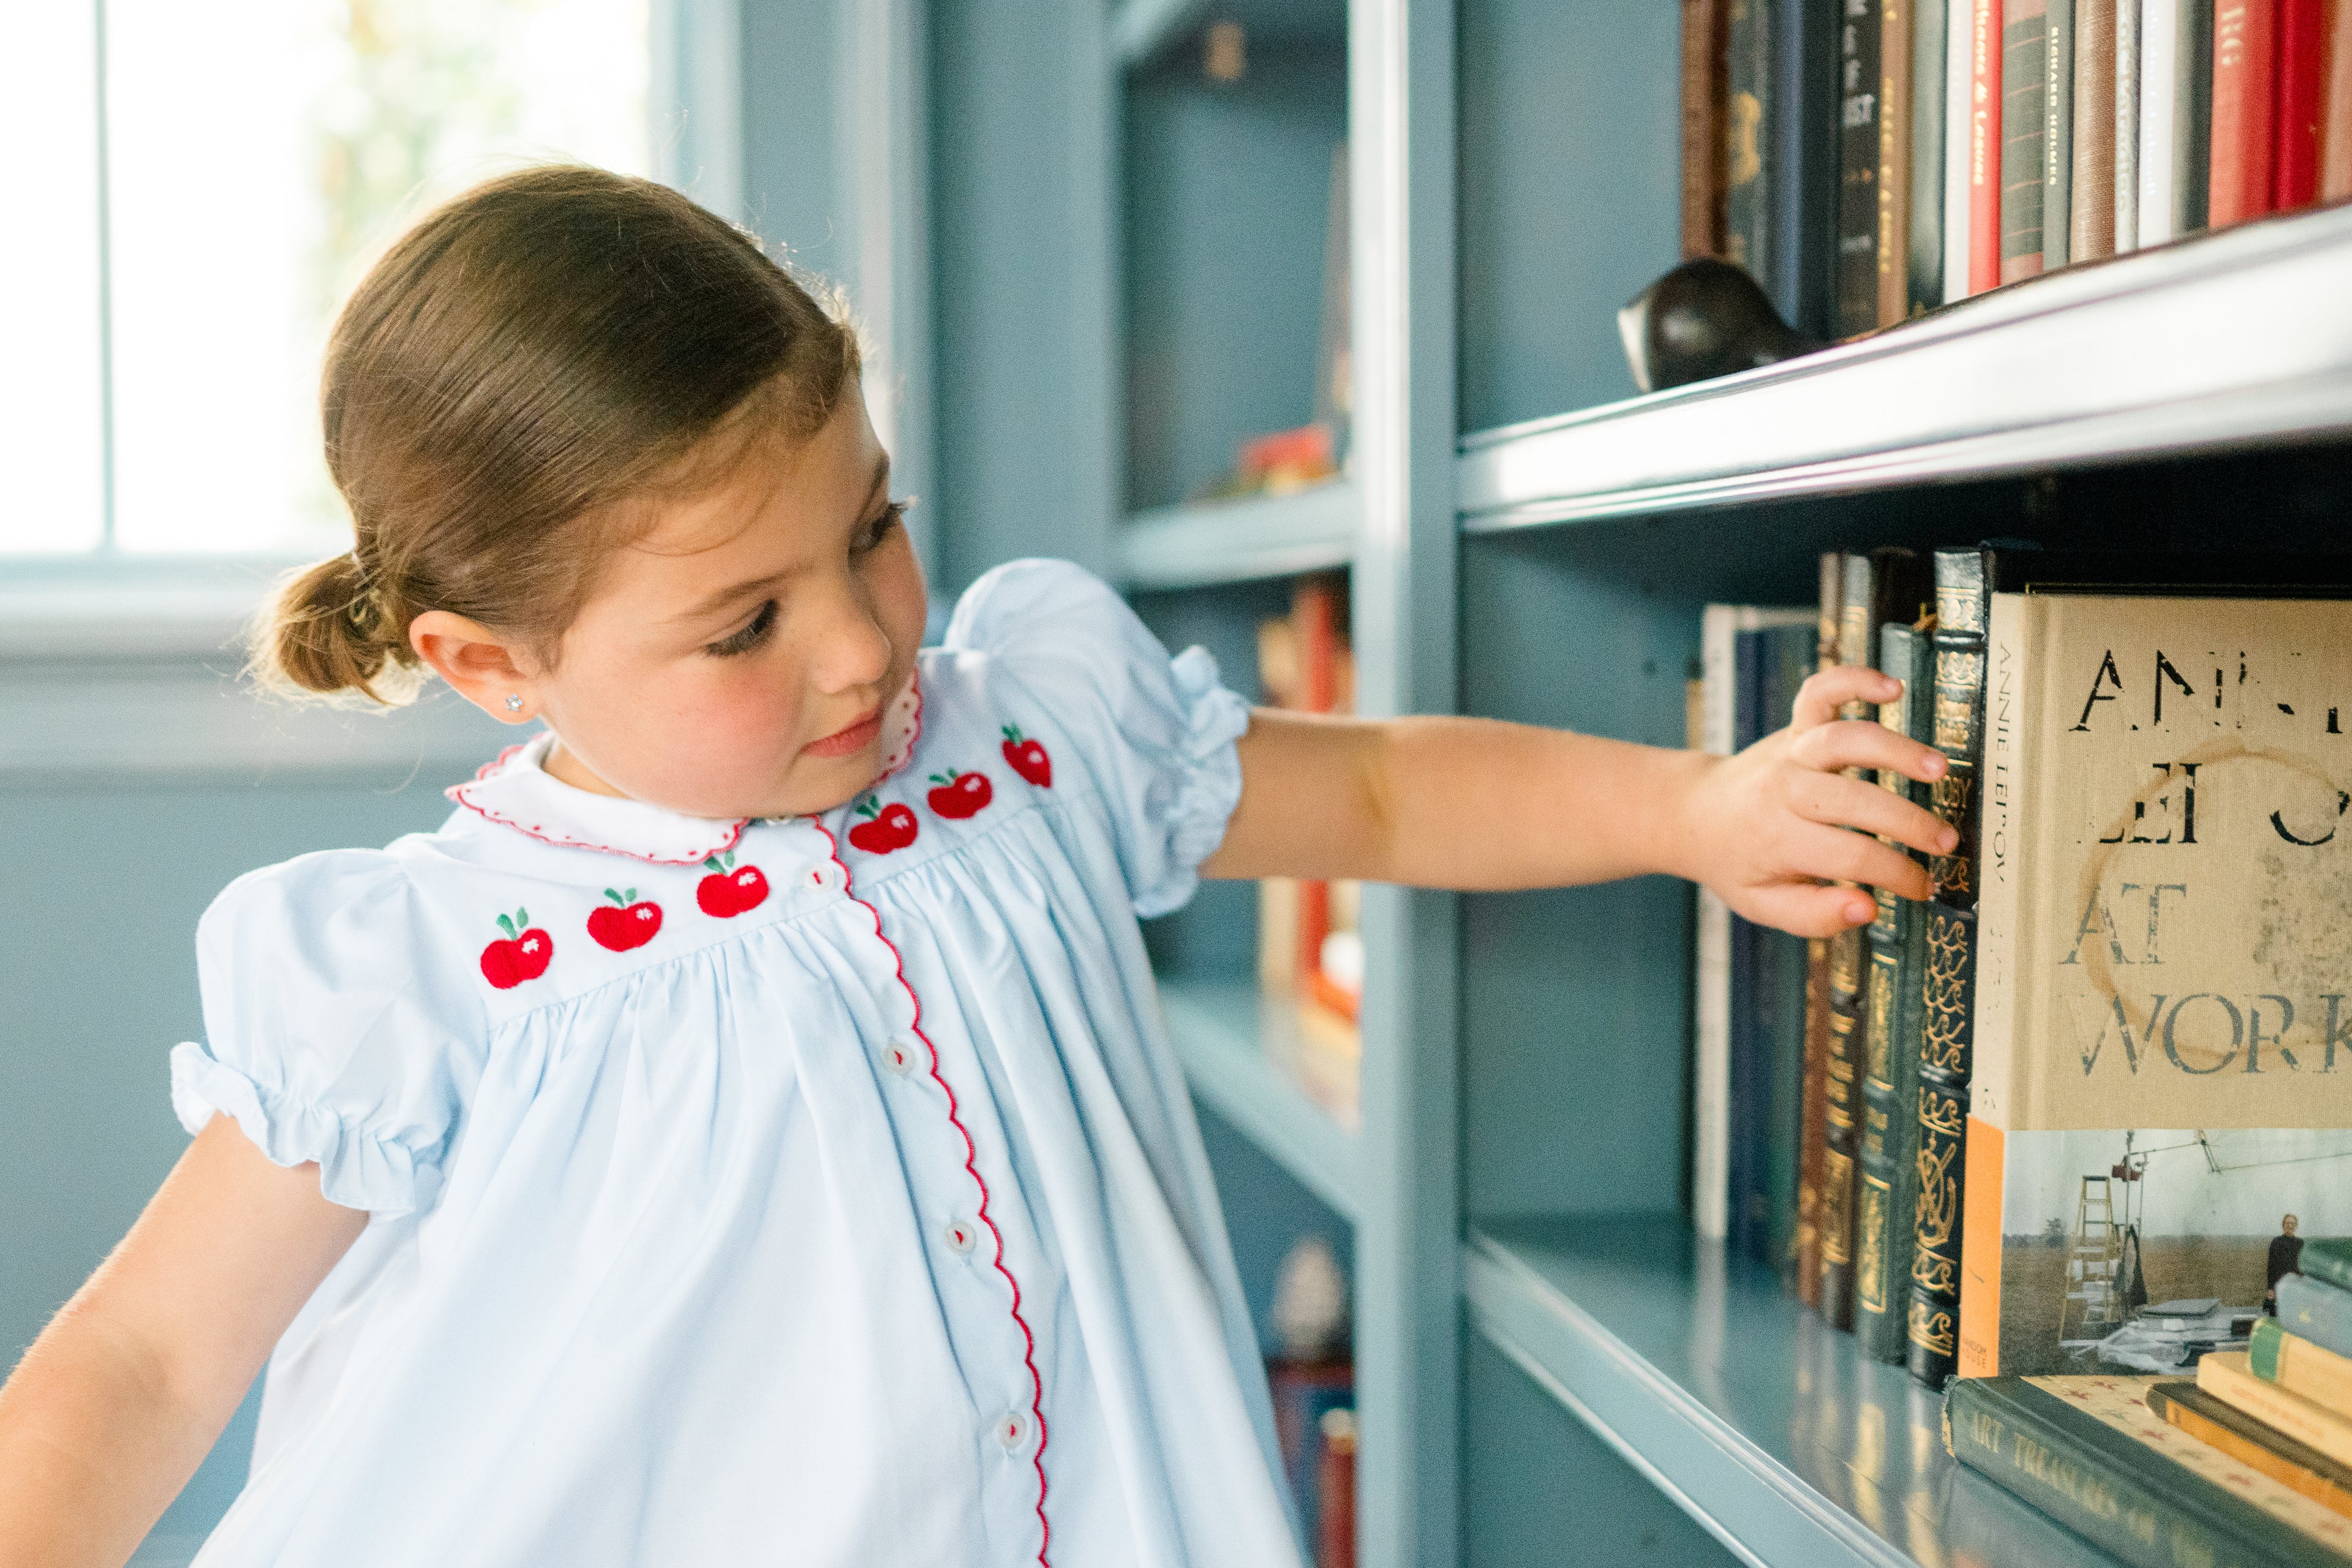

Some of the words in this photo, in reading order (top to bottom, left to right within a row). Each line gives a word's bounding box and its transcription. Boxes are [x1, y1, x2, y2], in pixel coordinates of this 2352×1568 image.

[2049, 26, 2059, 107] RICHARD
[2049, 114, 2057, 185] HOLMES
[1996, 641, 2011, 752] ANNIE
[2059, 882, 2187, 965] AT
[2058, 993, 2352, 1077] WORK
[1970, 1411, 2005, 1453] ART
